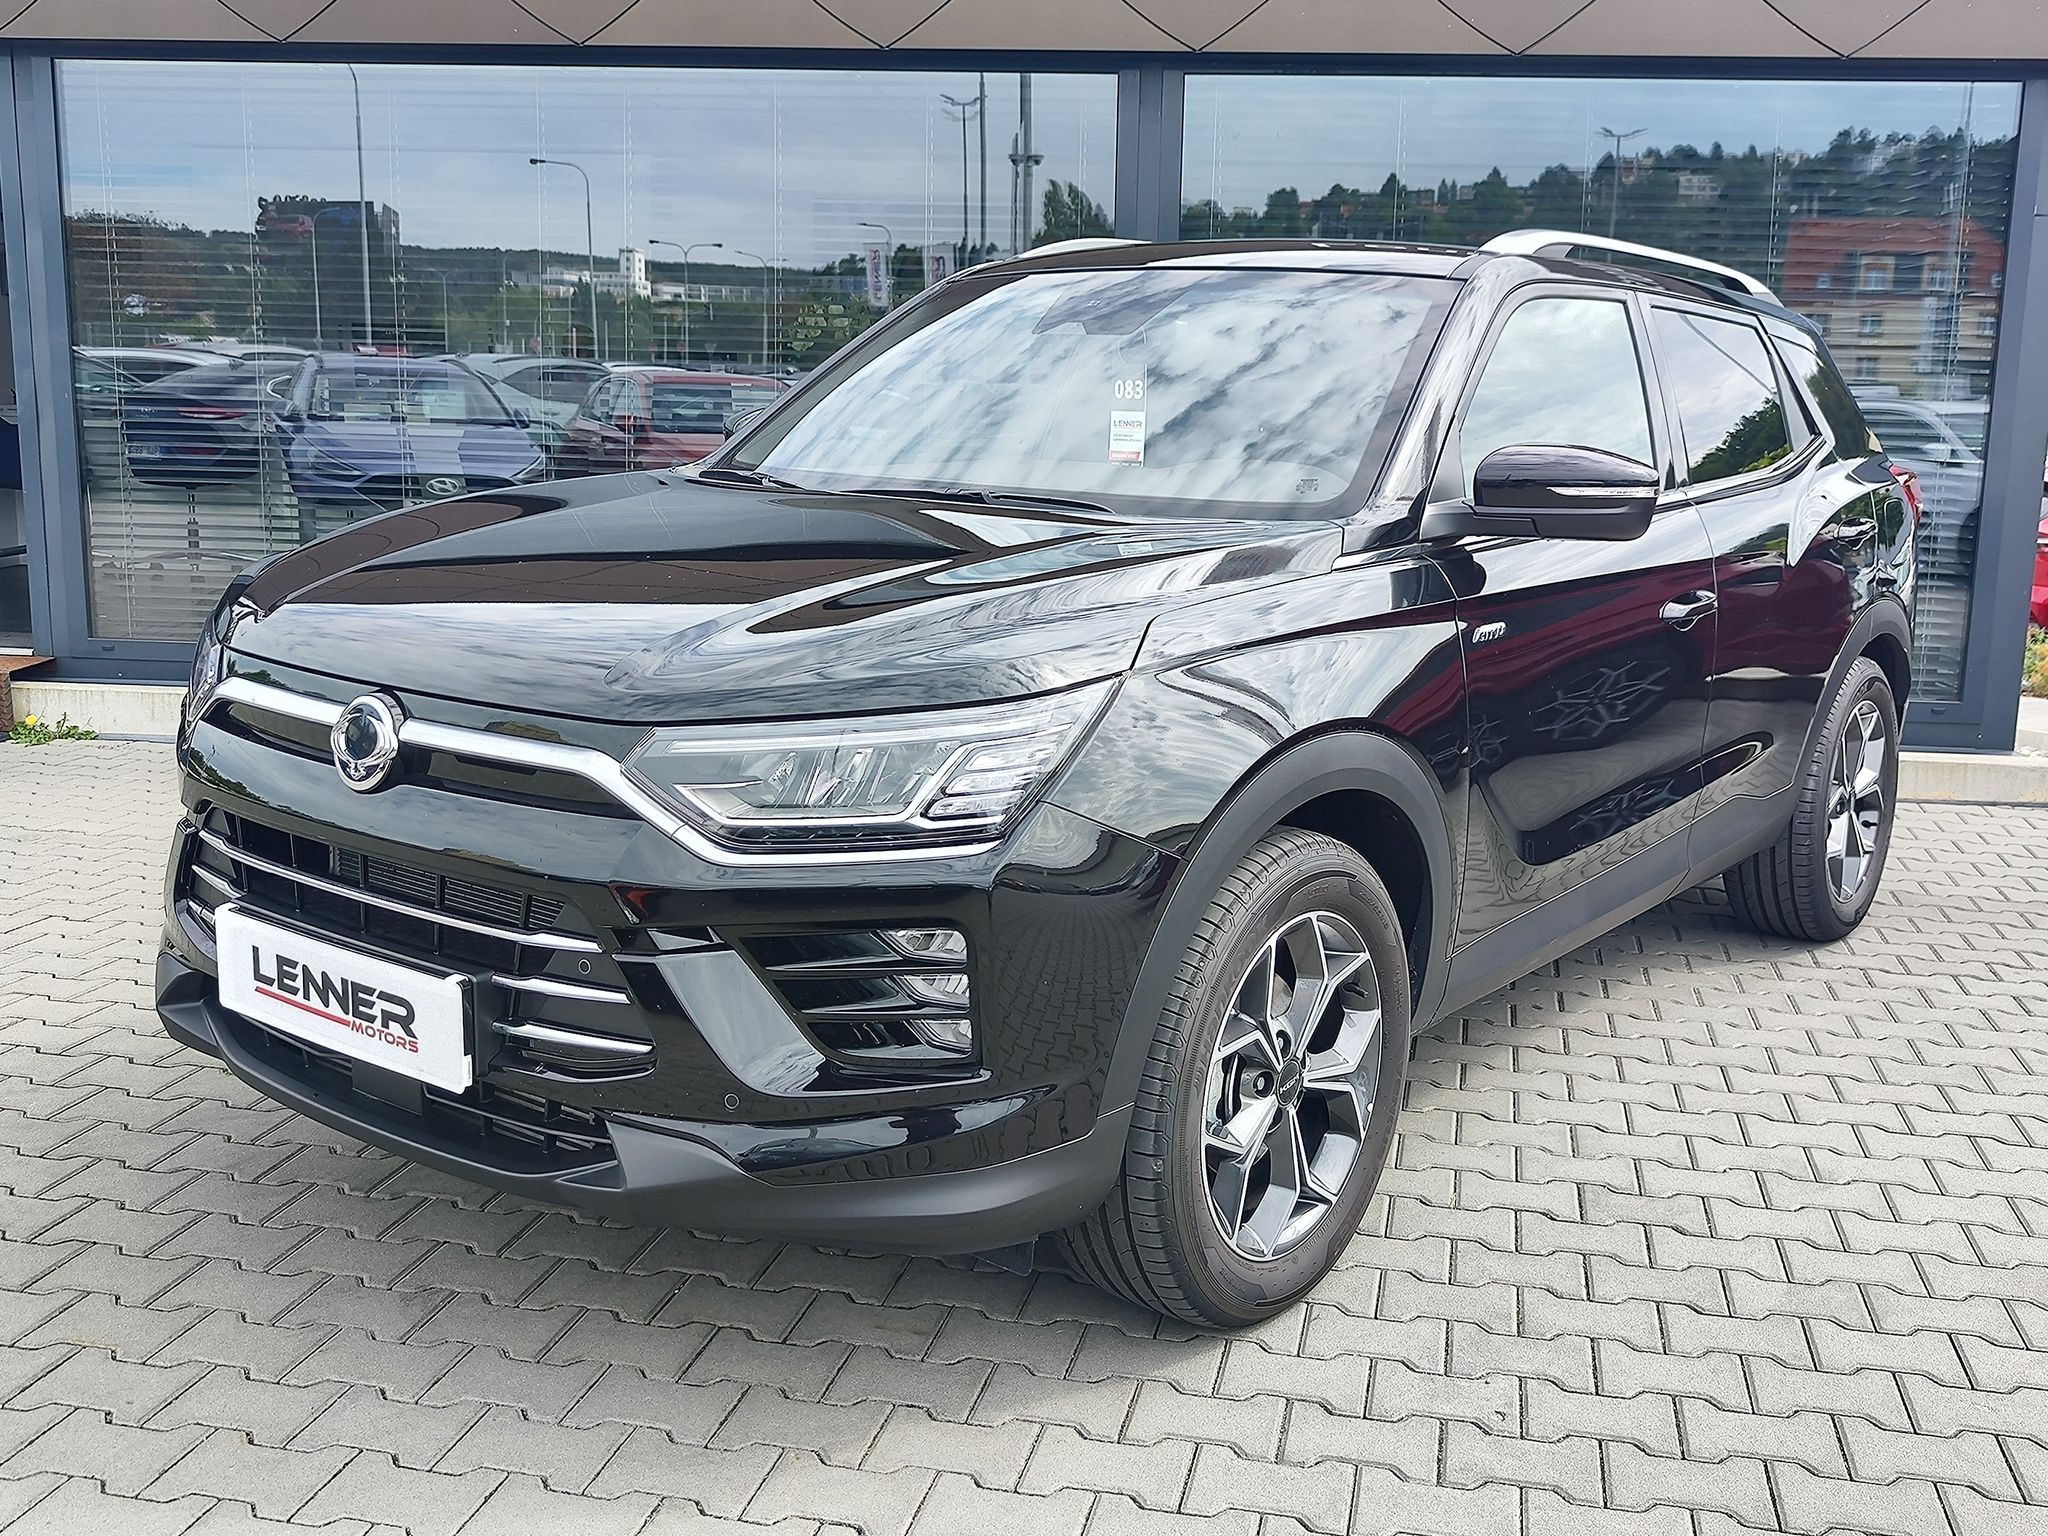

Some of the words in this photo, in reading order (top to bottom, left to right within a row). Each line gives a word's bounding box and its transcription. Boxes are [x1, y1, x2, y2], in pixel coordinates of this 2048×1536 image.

[1114, 379, 1144, 400] 083
[1113, 419, 1143, 428] LENNER
[252, 945, 418, 1040] LENNER
[350, 1020, 419, 1053] MOTORS
